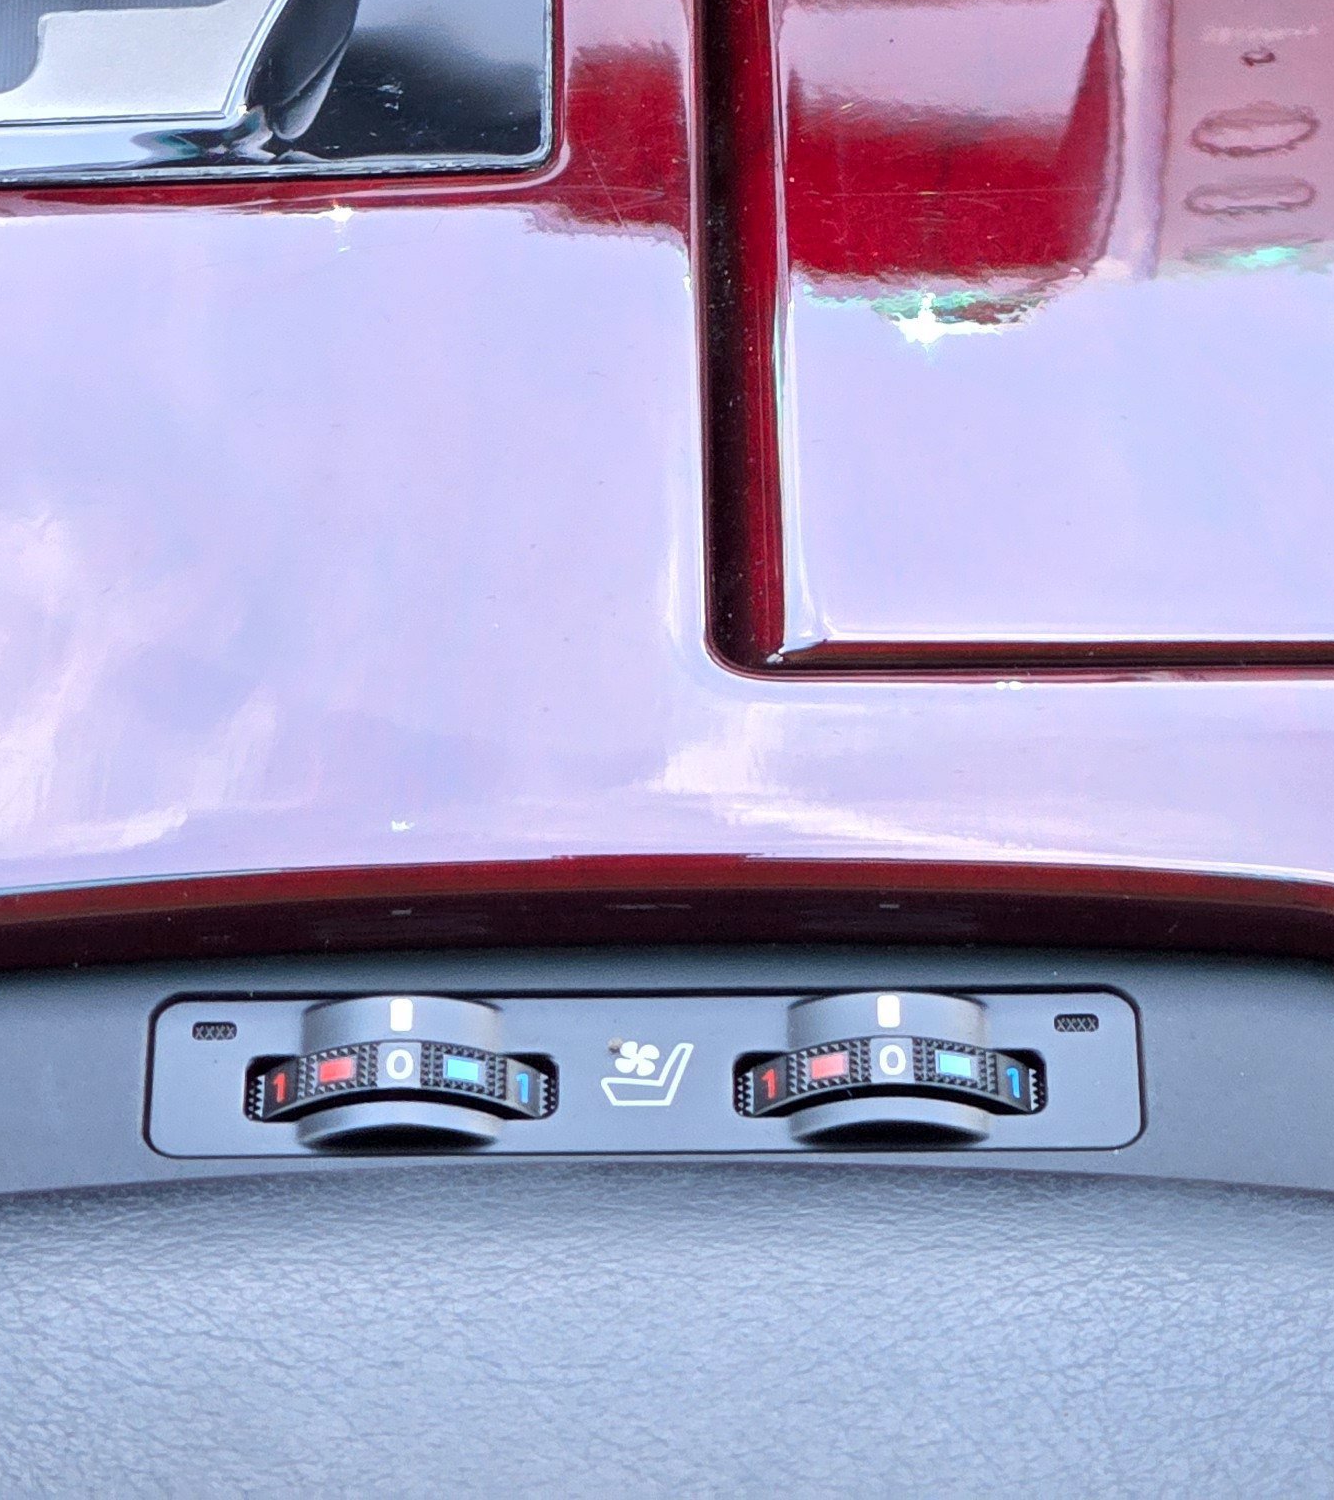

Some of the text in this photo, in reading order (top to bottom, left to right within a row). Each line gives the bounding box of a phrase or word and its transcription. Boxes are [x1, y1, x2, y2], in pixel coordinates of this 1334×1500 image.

[273, 1072, 287, 1103] 1
[516, 1072, 530, 1104] 1
[762, 1068, 777, 1100] 1
[1006, 1066, 1021, 1099] 1
